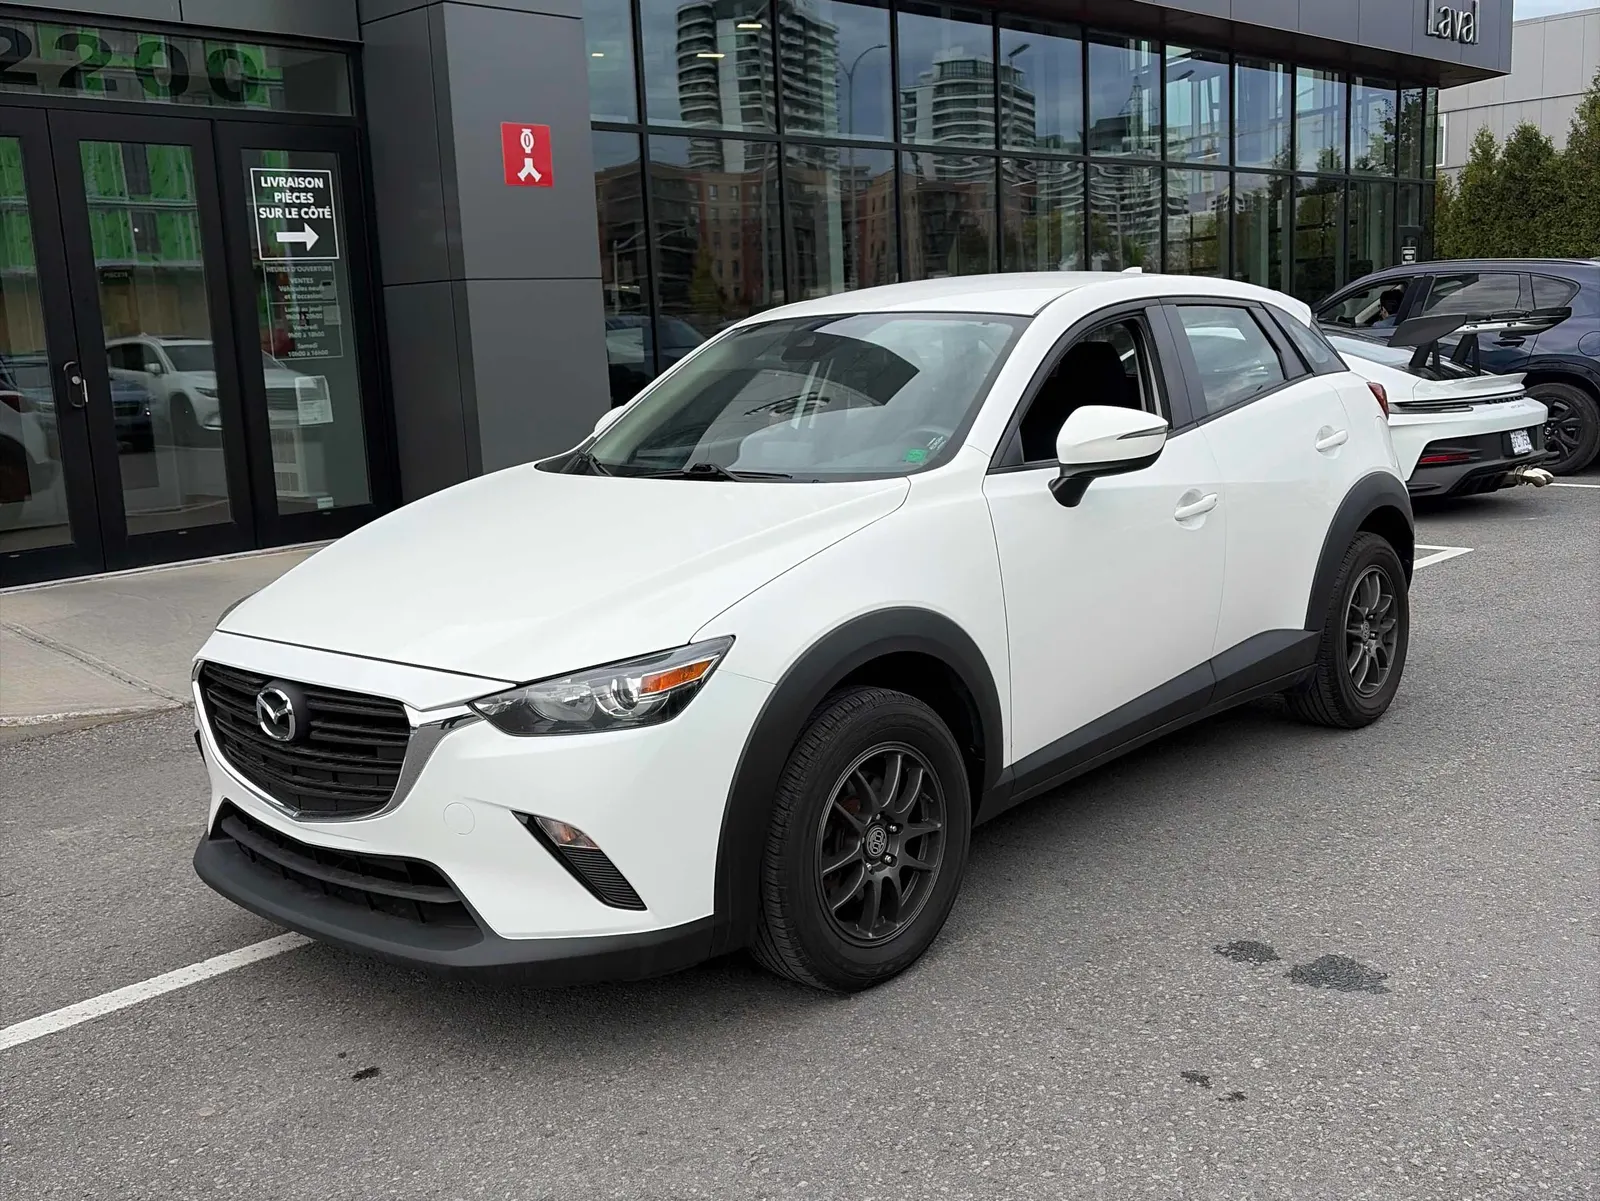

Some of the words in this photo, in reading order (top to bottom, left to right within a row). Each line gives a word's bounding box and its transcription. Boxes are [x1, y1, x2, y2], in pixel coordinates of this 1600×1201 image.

[1427, 0, 1479, 44] Laval
[260, 176, 324, 189] LIVRAISON
[273, 189, 315, 204] PIÈCES
[259, 207, 284, 219] SUR
[285, 207, 299, 219] LE
[300, 205, 332, 219] CÔTÉ
[266, 265, 289, 273] HEURES
